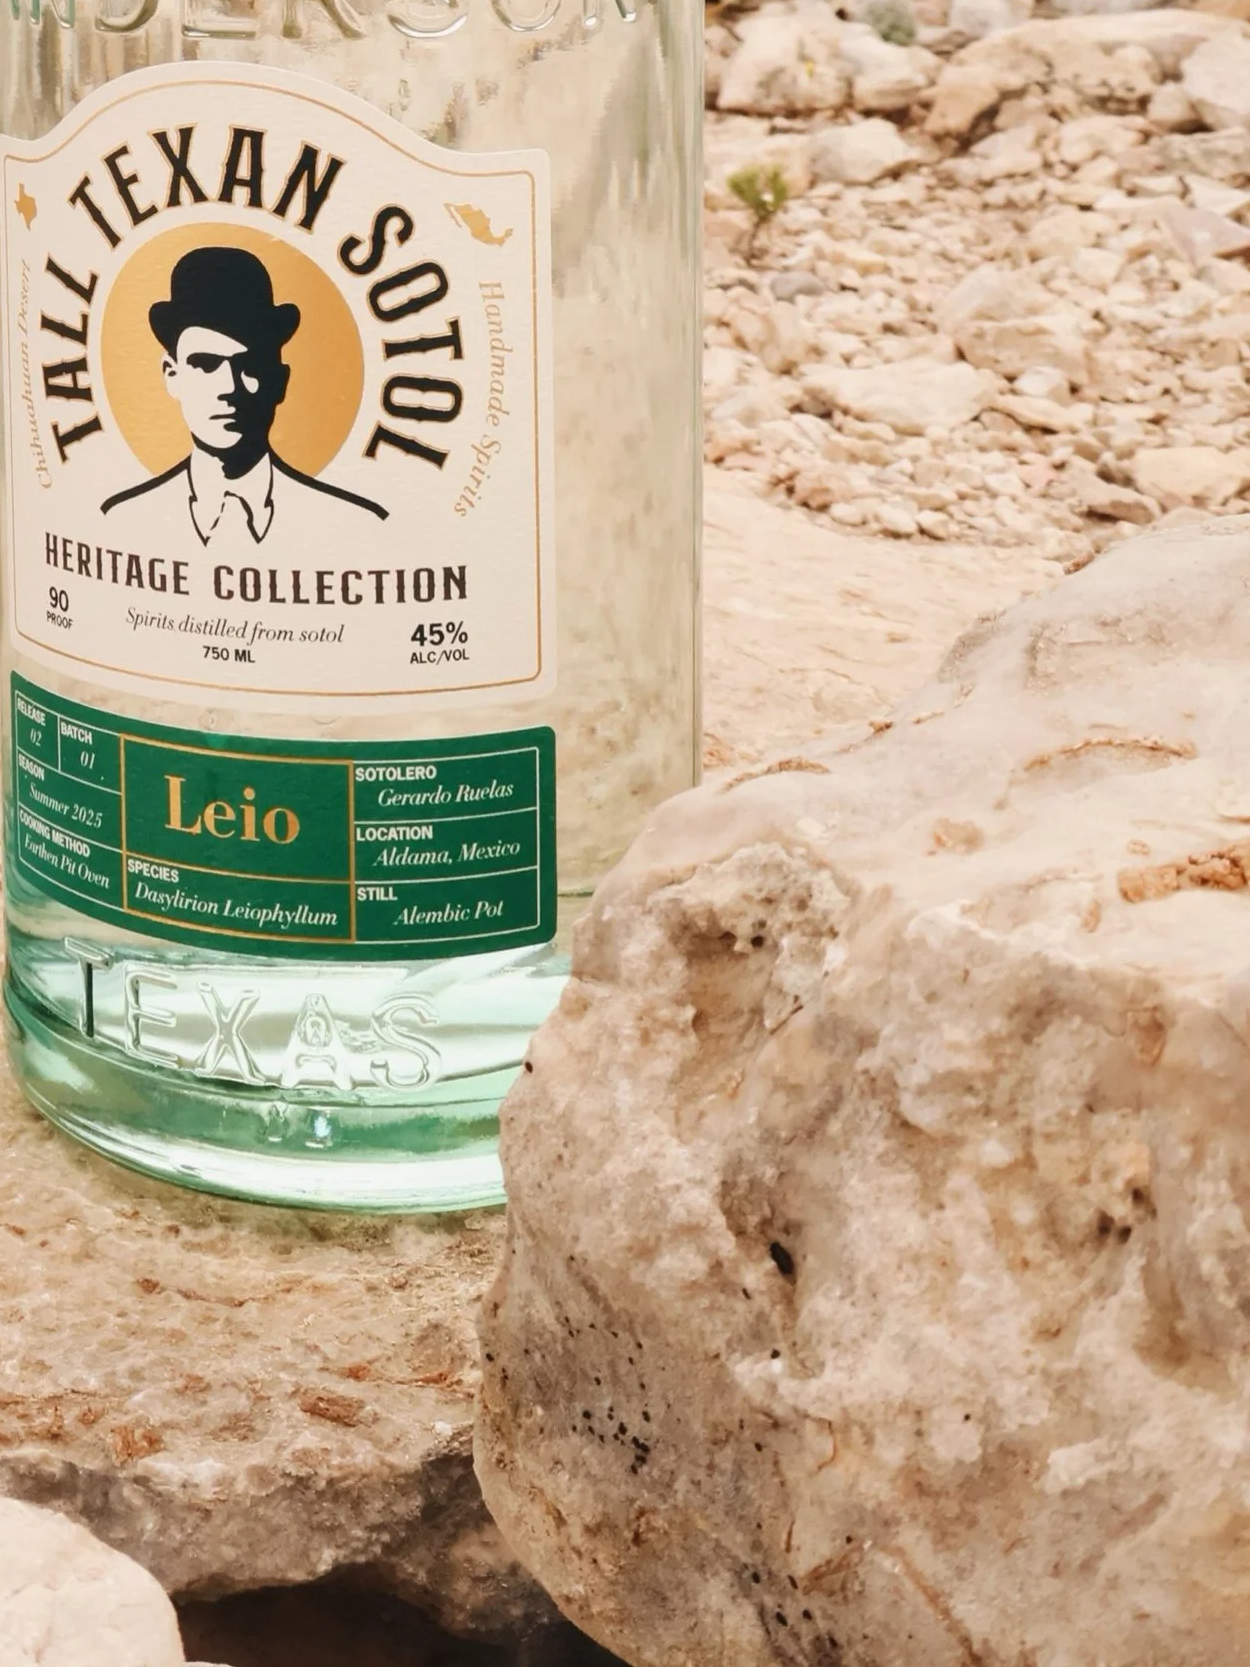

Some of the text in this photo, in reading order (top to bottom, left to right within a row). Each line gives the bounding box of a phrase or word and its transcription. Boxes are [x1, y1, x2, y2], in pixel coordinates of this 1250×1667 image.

[40, 122, 466, 471] TALL TEXAN SOTOL
[454, 282, 513, 517] Handmade Spirits
[45, 532, 467, 605] HERITAGE COLLECTION
[49, 586, 69, 612] 90
[46, 610, 73, 630] PROOF
[126, 606, 345, 646] Spirits distilled from sotol
[411, 621, 469, 647] 45%
[202, 645, 255, 664] 750 ML
[410, 648, 470, 665] ALC/VOL
[17, 697, 46, 727] RELEASE
[30, 728, 42, 747] 02
[60, 721, 93, 745] BATCH
[18, 753, 45, 782] SEASON
[80, 750, 95, 770] 01
[355, 765, 437, 781] SOTOLERO
[29, 782, 103, 829] Summer 2025
[377, 779, 514, 806] Gerardo Ruelas
[164, 774, 300, 845] Leio
[19, 809, 90, 858] COOKING METHOD
[356, 825, 433, 841] LOCATION
[24, 833, 110, 889] Earthen Pit Oven
[373, 840, 521, 867] Aldama, Mexico
[128, 859, 179, 883] SPECIES
[135, 881, 338, 930] Dasylirion Leiophyllum
[357, 887, 398, 901] STILL
[393, 900, 503, 925] Alembic Pot
[63, 936, 446, 1091] TEXAS
